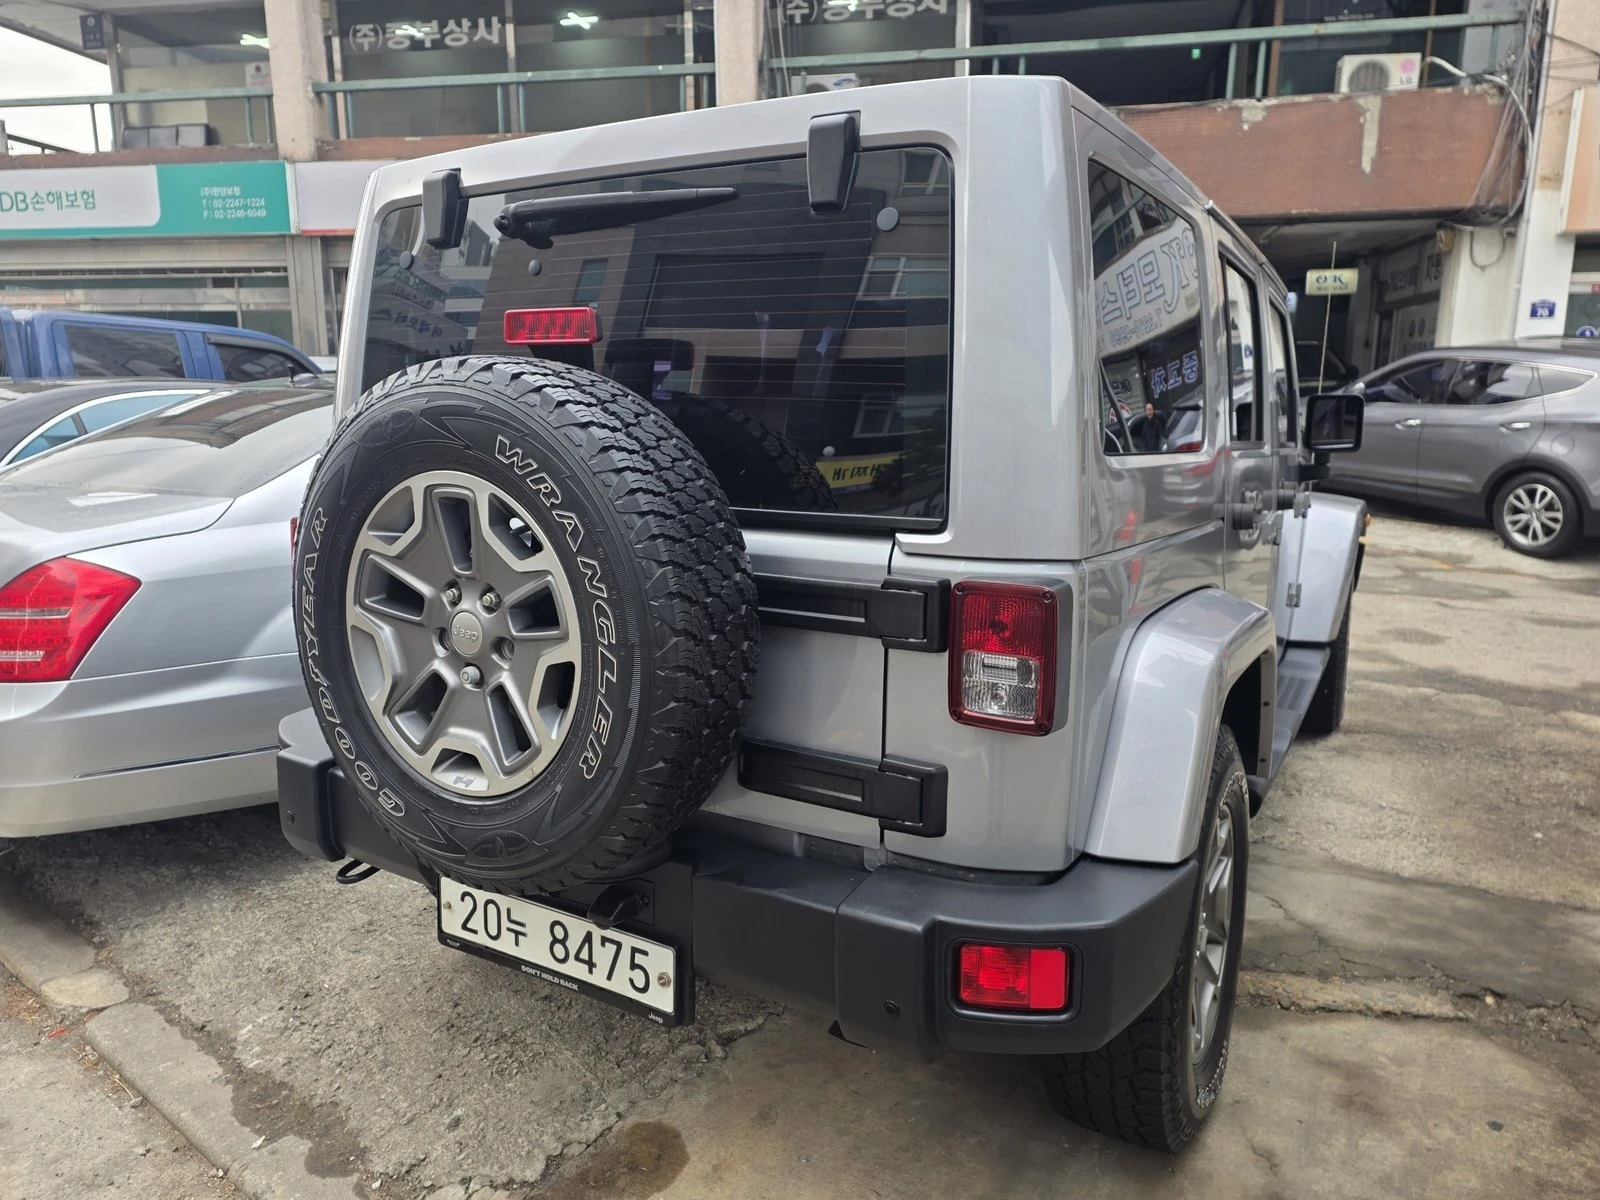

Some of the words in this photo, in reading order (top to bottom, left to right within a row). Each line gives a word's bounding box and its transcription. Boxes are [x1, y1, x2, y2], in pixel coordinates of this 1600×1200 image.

[1399, 75, 1413, 85] LG
[495, 434, 617, 779] WRANGLER
[453, 624, 478, 642] Jeep
[302, 507, 405, 816] GOODYEAR
[460, 891, 528, 947] 20누
[549, 920, 651, 994] 8475
[521, 965, 542, 977] DON'T
[541, 972, 560, 984] HOLD
[560, 979, 579, 991] BACK
[648, 1013, 664, 1024] Jeep
